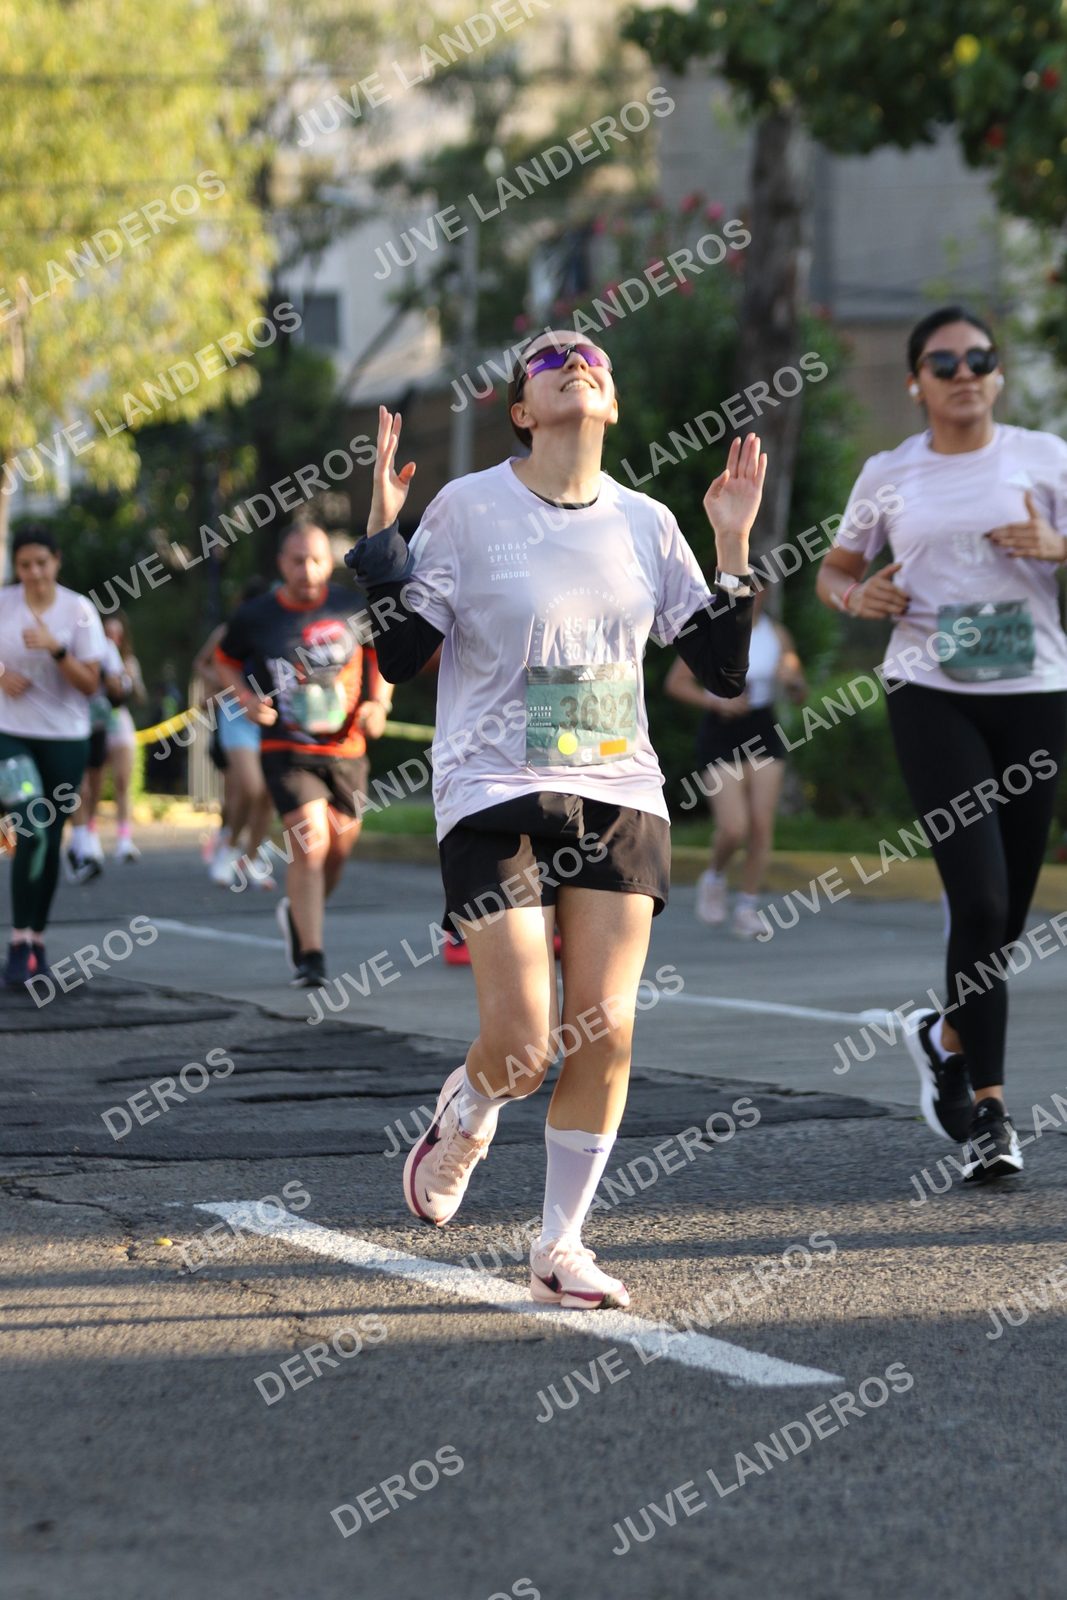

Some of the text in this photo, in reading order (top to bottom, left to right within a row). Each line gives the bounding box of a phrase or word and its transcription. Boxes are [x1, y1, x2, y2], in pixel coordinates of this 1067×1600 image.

[487, 541, 528, 552] ADIDAS
[490, 552, 528, 563] SPLITS
[560, 691, 634, 730] 3692
